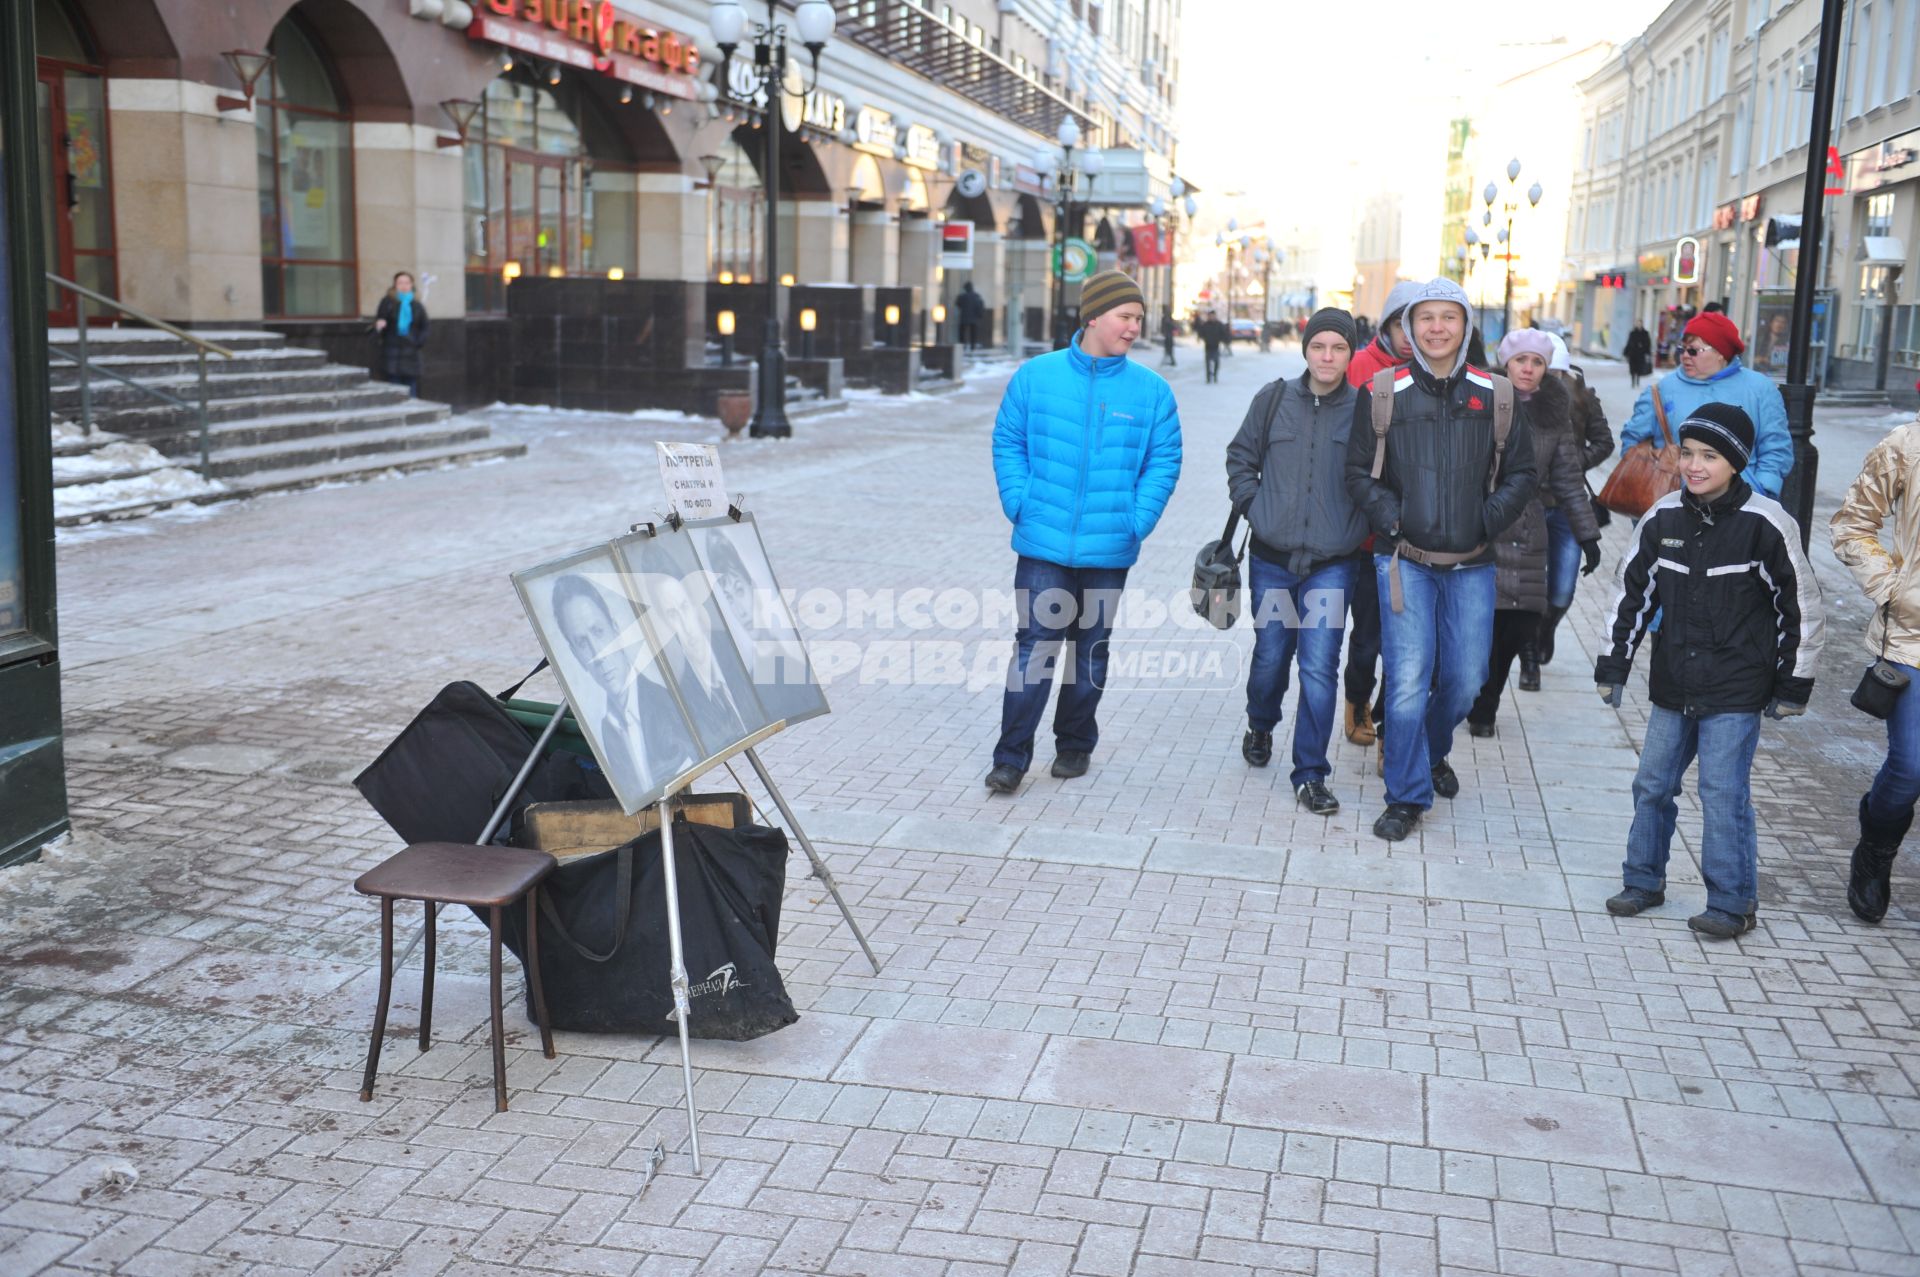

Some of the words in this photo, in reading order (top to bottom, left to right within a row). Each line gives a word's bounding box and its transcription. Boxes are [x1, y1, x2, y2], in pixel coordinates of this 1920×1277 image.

[666, 456, 713, 467] ПОРТРЕТЫ
[675, 480, 679, 489] С
[680, 480, 706, 488] НАТУРЫ
[708, 480, 713, 488] И
[684, 500, 693, 508] ПО
[695, 499, 711, 507] ФОТО
